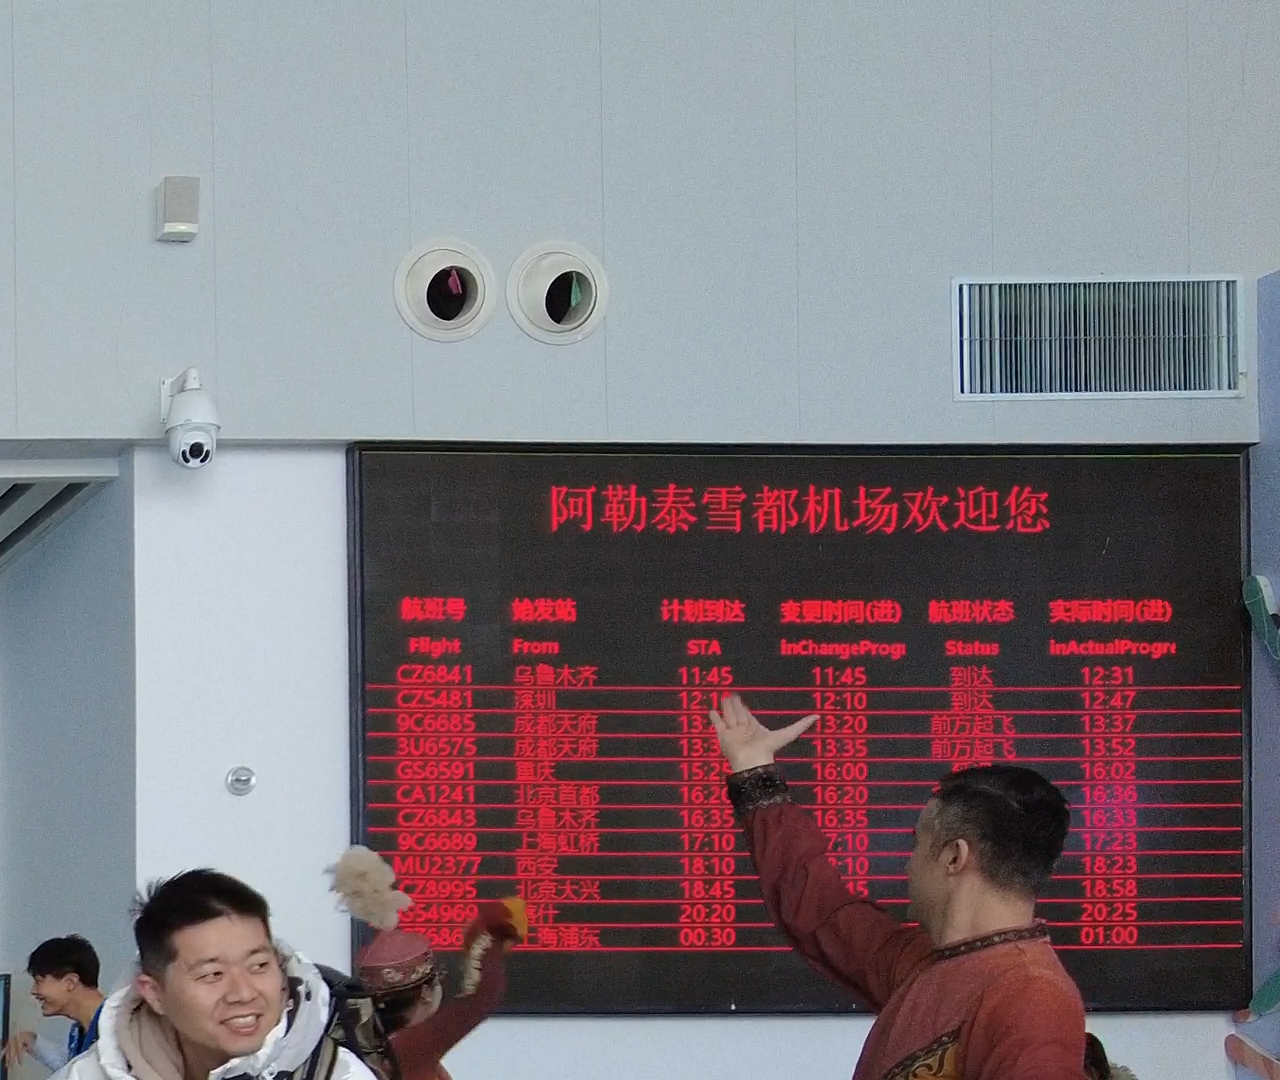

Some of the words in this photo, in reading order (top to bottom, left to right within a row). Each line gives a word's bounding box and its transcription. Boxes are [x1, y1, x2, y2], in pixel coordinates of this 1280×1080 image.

[550, 484, 1051, 536] 阿勒泰雪都机场欢迎您
[400, 596, 467, 621] 航班号
[511, 597, 577, 622] 始发站
[660, 599, 746, 623] 计划到达
[928, 600, 1015, 624] 航班状态
[408, 637, 461, 658] Flight
[512, 638, 560, 655] From
[687, 640, 722, 656] STA
[945, 640, 1000, 656] Status
[396, 664, 473, 684] CZ6841
[513, 663, 599, 686] 乌鲁木齐
[679, 667, 733, 685] 11:45
[812, 667, 866, 685] 11:45
[950, 666, 994, 687] 到达
[1081, 666, 1134, 684] 12:31
[396, 689, 473, 709] CZ5481
[514, 689, 556, 710] 深圳
[679, 691, 731, 709] 12:1
[812, 691, 867, 709] 12:10
[950, 691, 994, 712] 到达
[1081, 691, 1135, 709] 12:47
[397, 714, 475, 732] 9C6685
[513, 713, 599, 735] 成都天府
[930, 714, 1016, 735] 前方起飞
[1080, 714, 1135, 732] 13:37
[397, 738, 476, 756] 3U6575
[513, 738, 599, 758] 成都天府
[812, 739, 868, 757] 13:35
[930, 738, 1016, 759] 前方起飞
[1081, 738, 1135, 757] 13:52
[397, 761, 475, 780] GS6591
[515, 761, 557, 783] 重庆
[812, 762, 868, 781] 16:00
[1081, 762, 1135, 780] 16:02
[396, 785, 475, 803] CA1241
[514, 784, 600, 806] 北京首都
[813, 785, 868, 804] 16:20
[1082, 785, 1137, 803] 16:36
[397, 808, 476, 827] CZ6843
[514, 808, 600, 829] 乌鲁木齐
[680, 809, 735, 828] 16:35
[813, 809, 868, 828] 16:35
[1082, 808, 1136, 827] 16:33
[398, 832, 477, 851] 9C6689
[516, 832, 600, 853] 上海虹桥
[680, 833, 735, 852] 17:10
[825, 833, 869, 852] 7:10
[1082, 832, 1137, 850] 17:23
[394, 856, 482, 875] MU2377
[516, 856, 558, 877] 西安
[680, 857, 735, 875] 18:10
[1082, 855, 1137, 874] 18:23
[516, 880, 601, 901] 北京大兴
[680, 880, 735, 899] 18:45
[1082, 879, 1137, 897] 18:58
[679, 904, 735, 922] 20:20
[1080, 903, 1137, 921] 20:25
[679, 927, 735, 947] 00:30
[1080, 926, 1137, 944] 01:00
